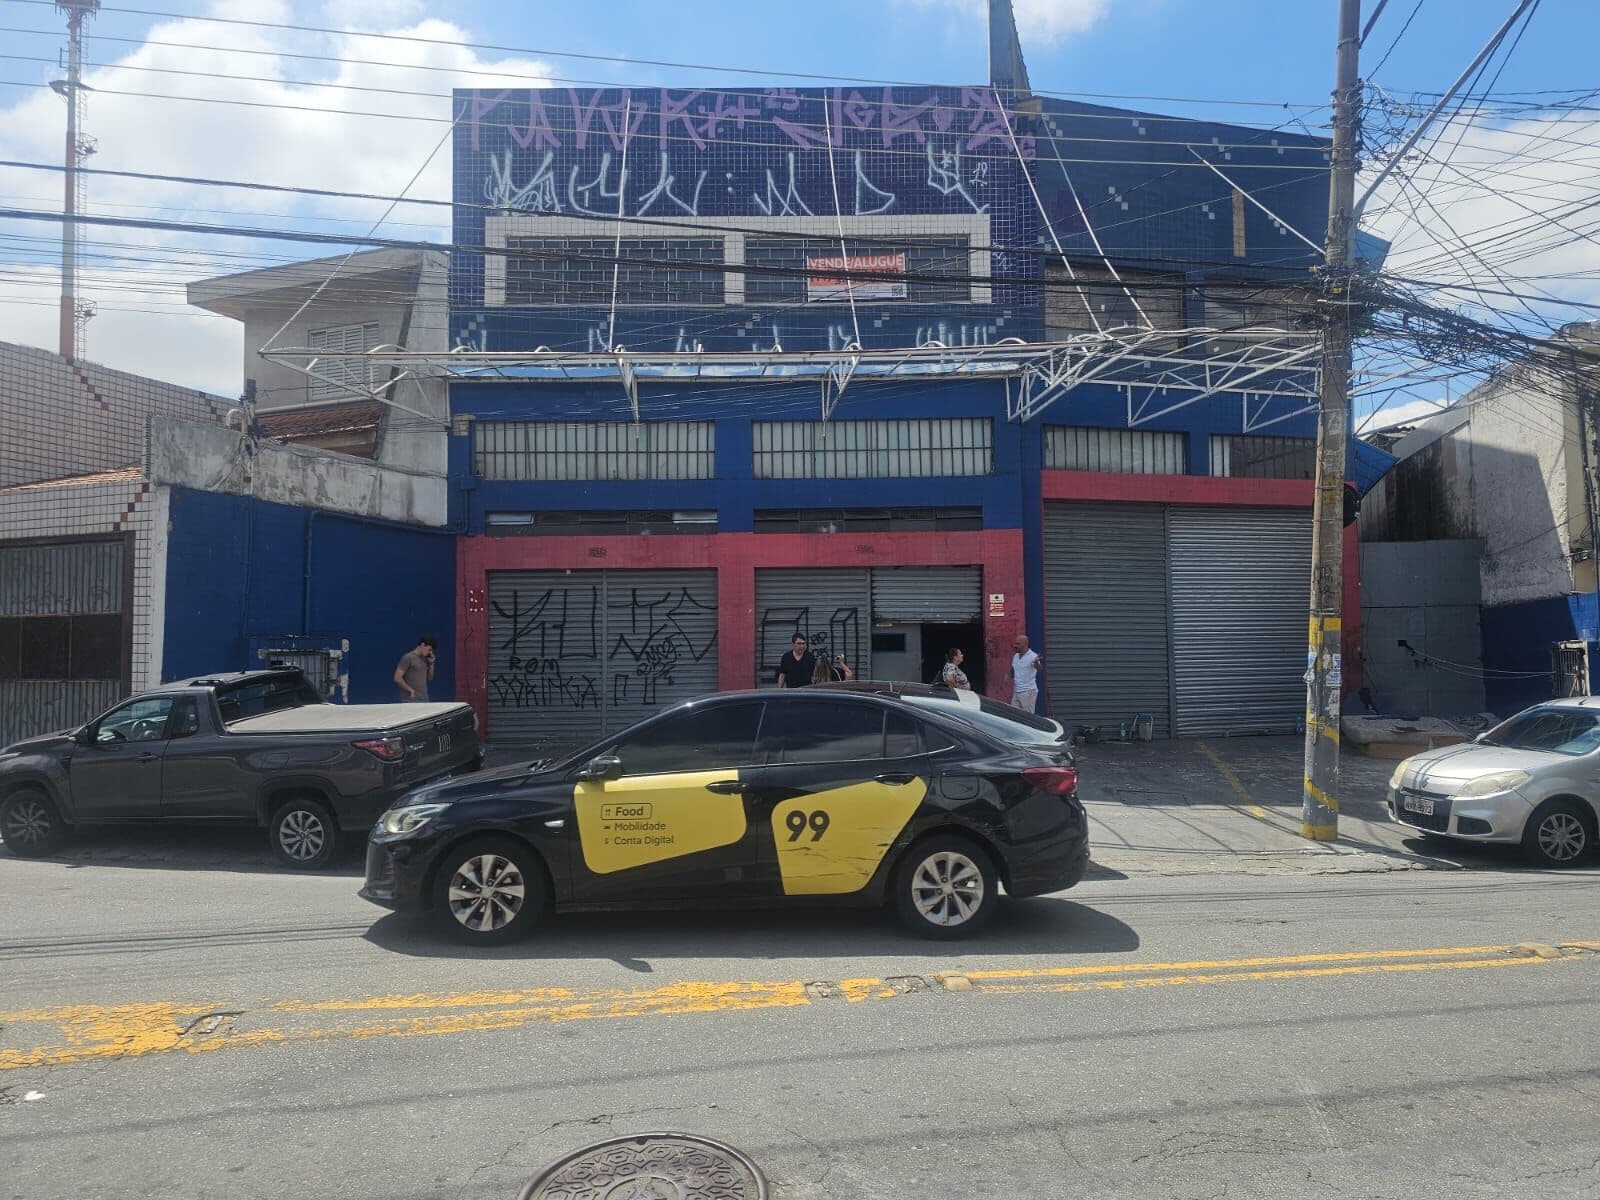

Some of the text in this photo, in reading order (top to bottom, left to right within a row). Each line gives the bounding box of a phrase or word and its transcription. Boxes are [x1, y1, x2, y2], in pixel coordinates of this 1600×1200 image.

[809, 255, 904, 269] VENDE/ALUGUE
[615, 806, 645, 816] Food
[614, 821, 667, 831] Mobilidade
[786, 810, 830, 842] 99
[614, 835, 674, 846] Conta Digital
